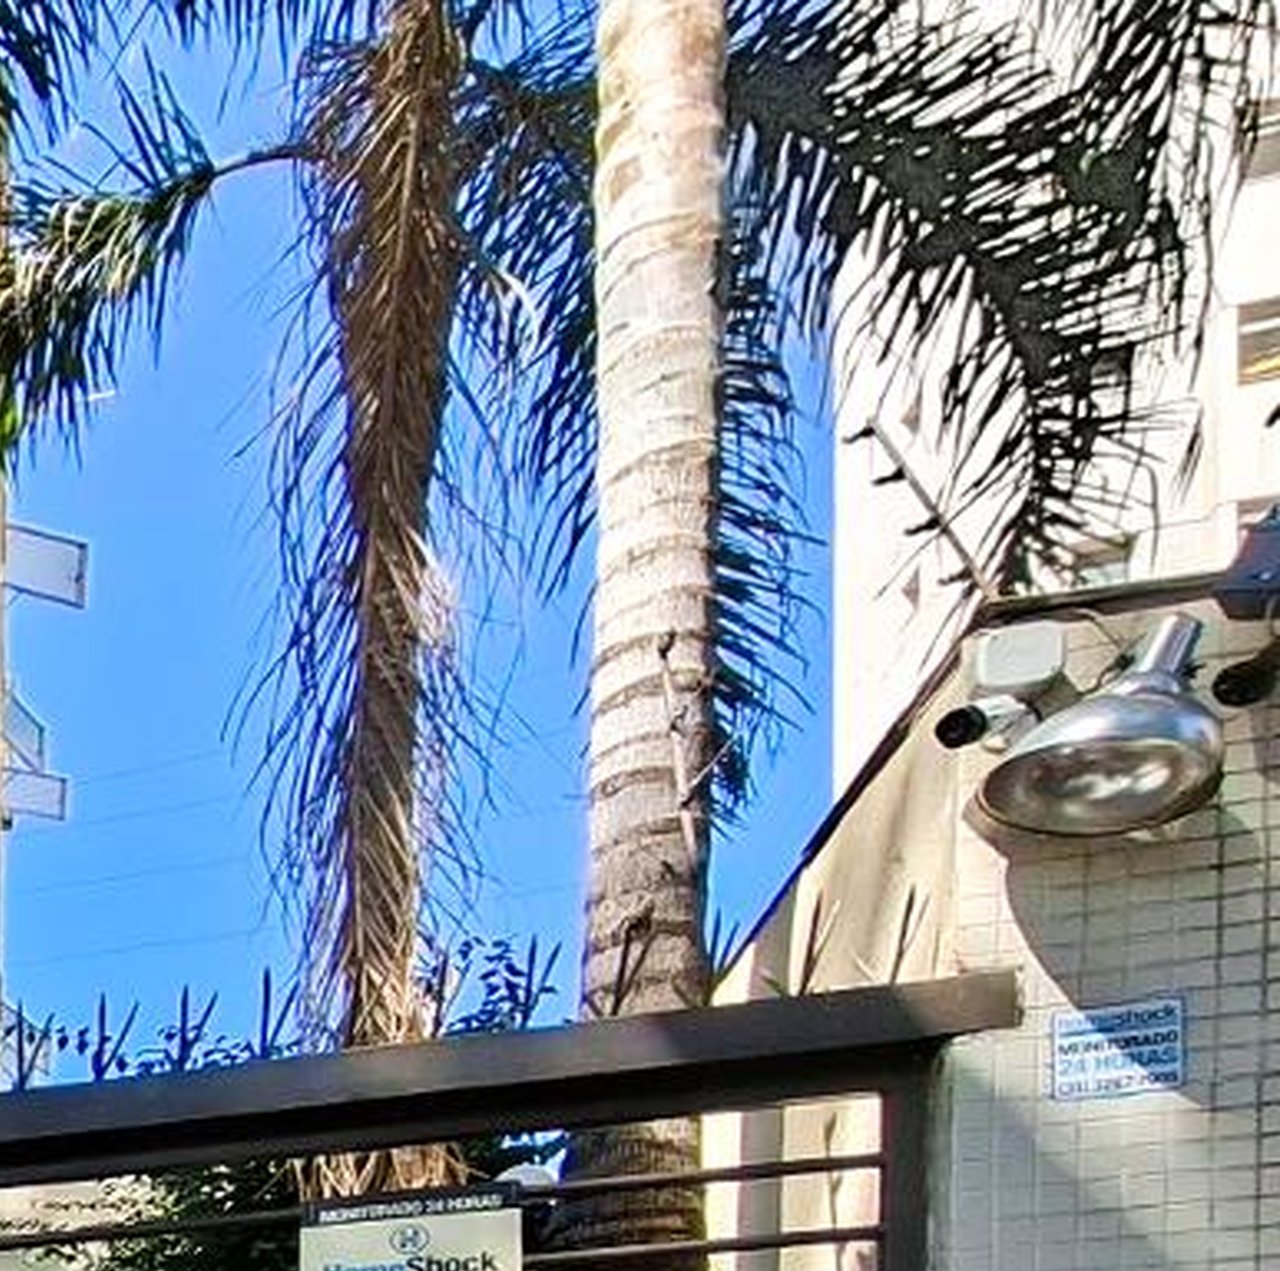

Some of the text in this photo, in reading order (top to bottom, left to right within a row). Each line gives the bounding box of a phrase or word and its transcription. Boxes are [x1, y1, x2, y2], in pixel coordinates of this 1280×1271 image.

[1058, 1029, 1178, 1055] MONITORADO
[1058, 1045, 1178, 1075] 24 HORAS
[318, 1201, 423, 1224] MONITORADO
[448, 1194, 504, 1210] HORAS
